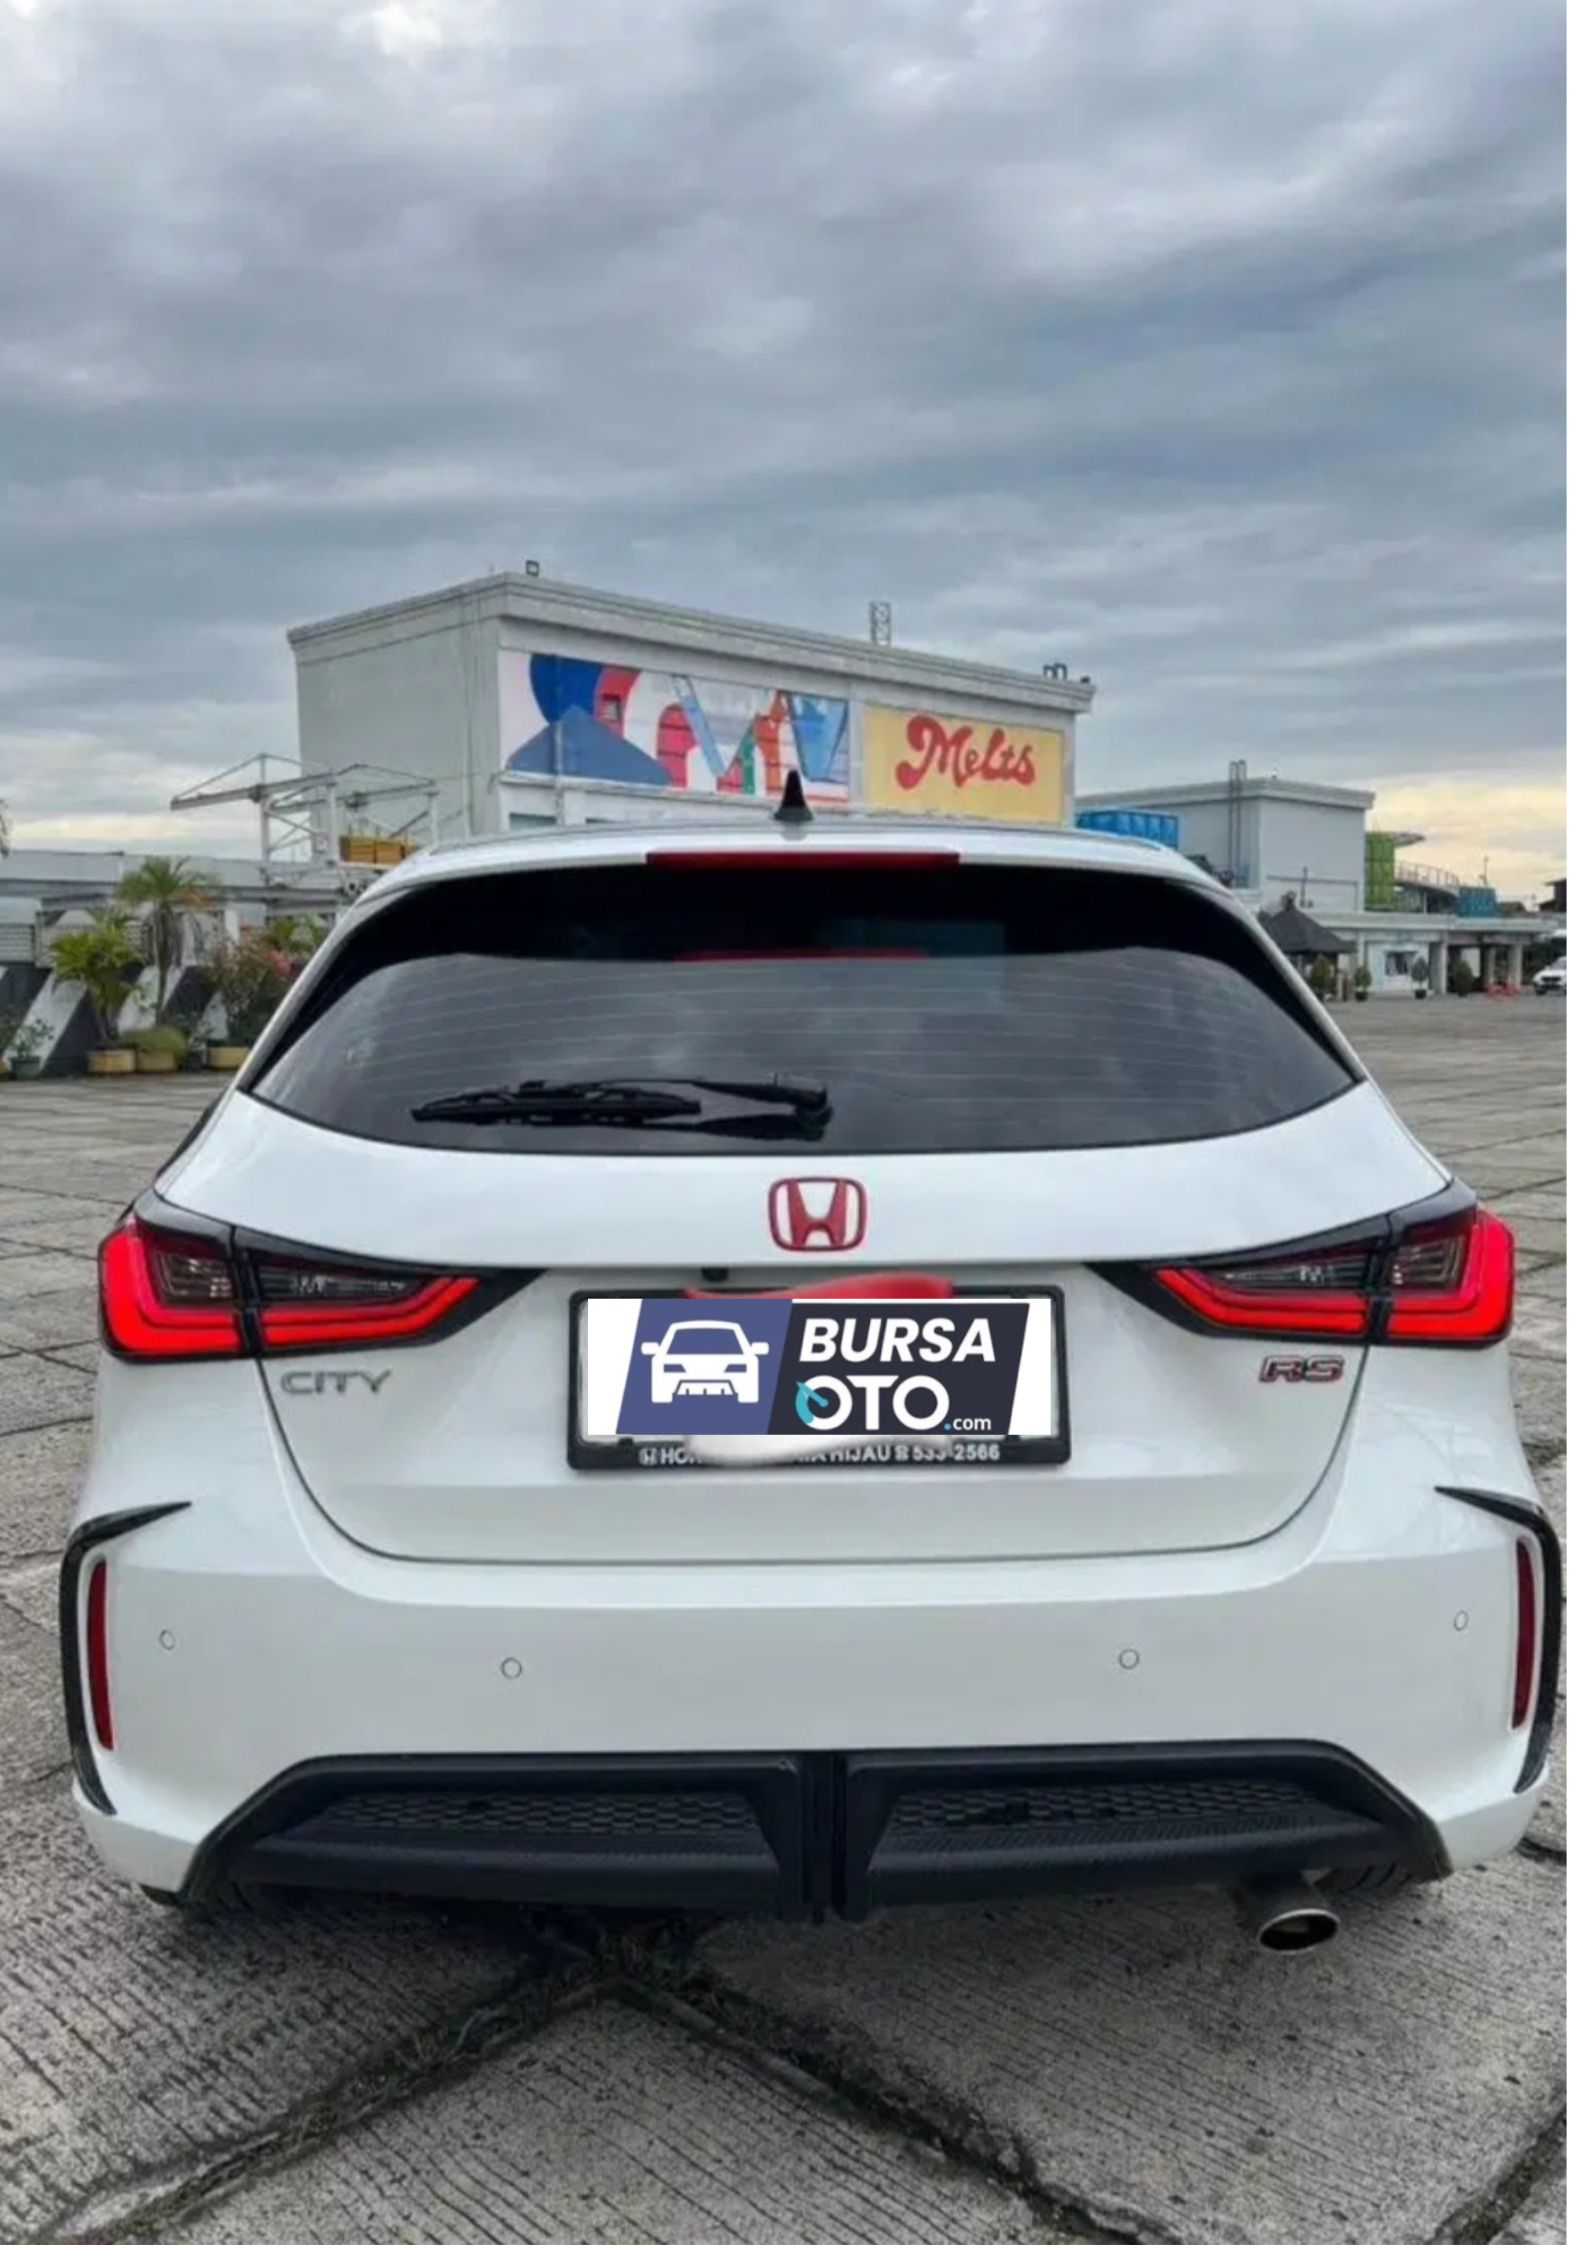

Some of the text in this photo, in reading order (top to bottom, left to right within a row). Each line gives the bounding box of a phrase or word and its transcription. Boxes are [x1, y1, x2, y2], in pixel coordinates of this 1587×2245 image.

[896, 715, 1035, 790] Melts
[281, 1370, 391, 1394] CITY
[1259, 1354, 1345, 1383] RS
